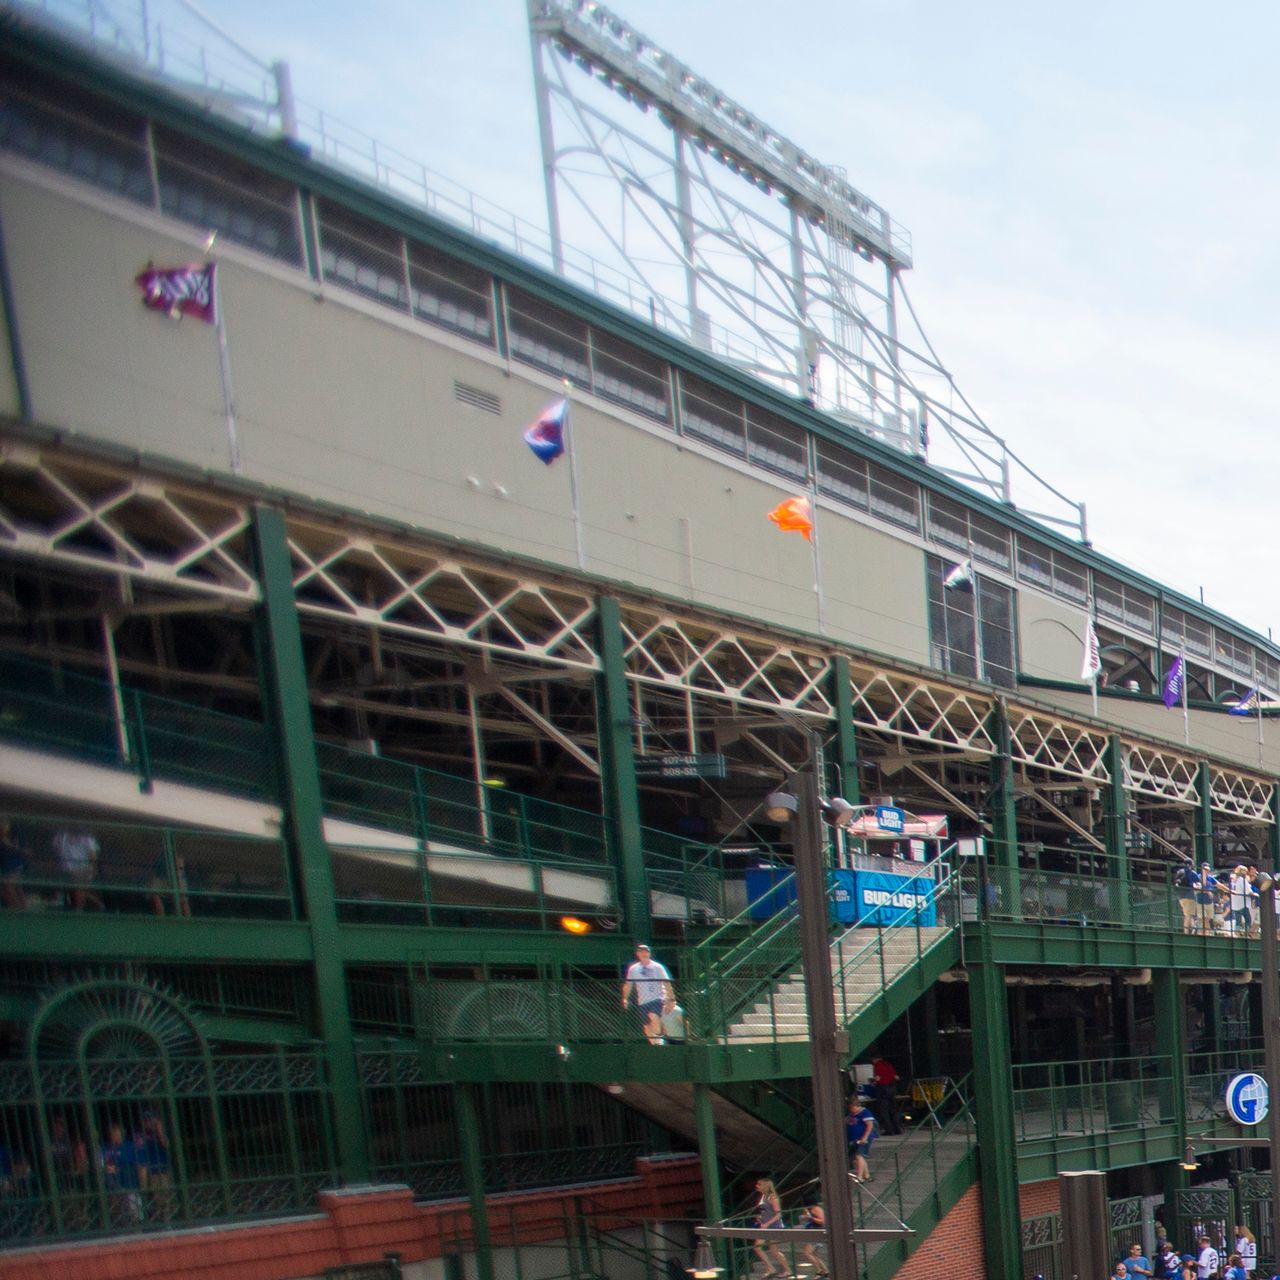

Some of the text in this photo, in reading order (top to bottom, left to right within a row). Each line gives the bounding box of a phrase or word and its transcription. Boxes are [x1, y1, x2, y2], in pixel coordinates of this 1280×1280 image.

[882, 810, 899, 819] BUD
[880, 818, 902, 829] LIGHT
[863, 889, 891, 906] BUD
